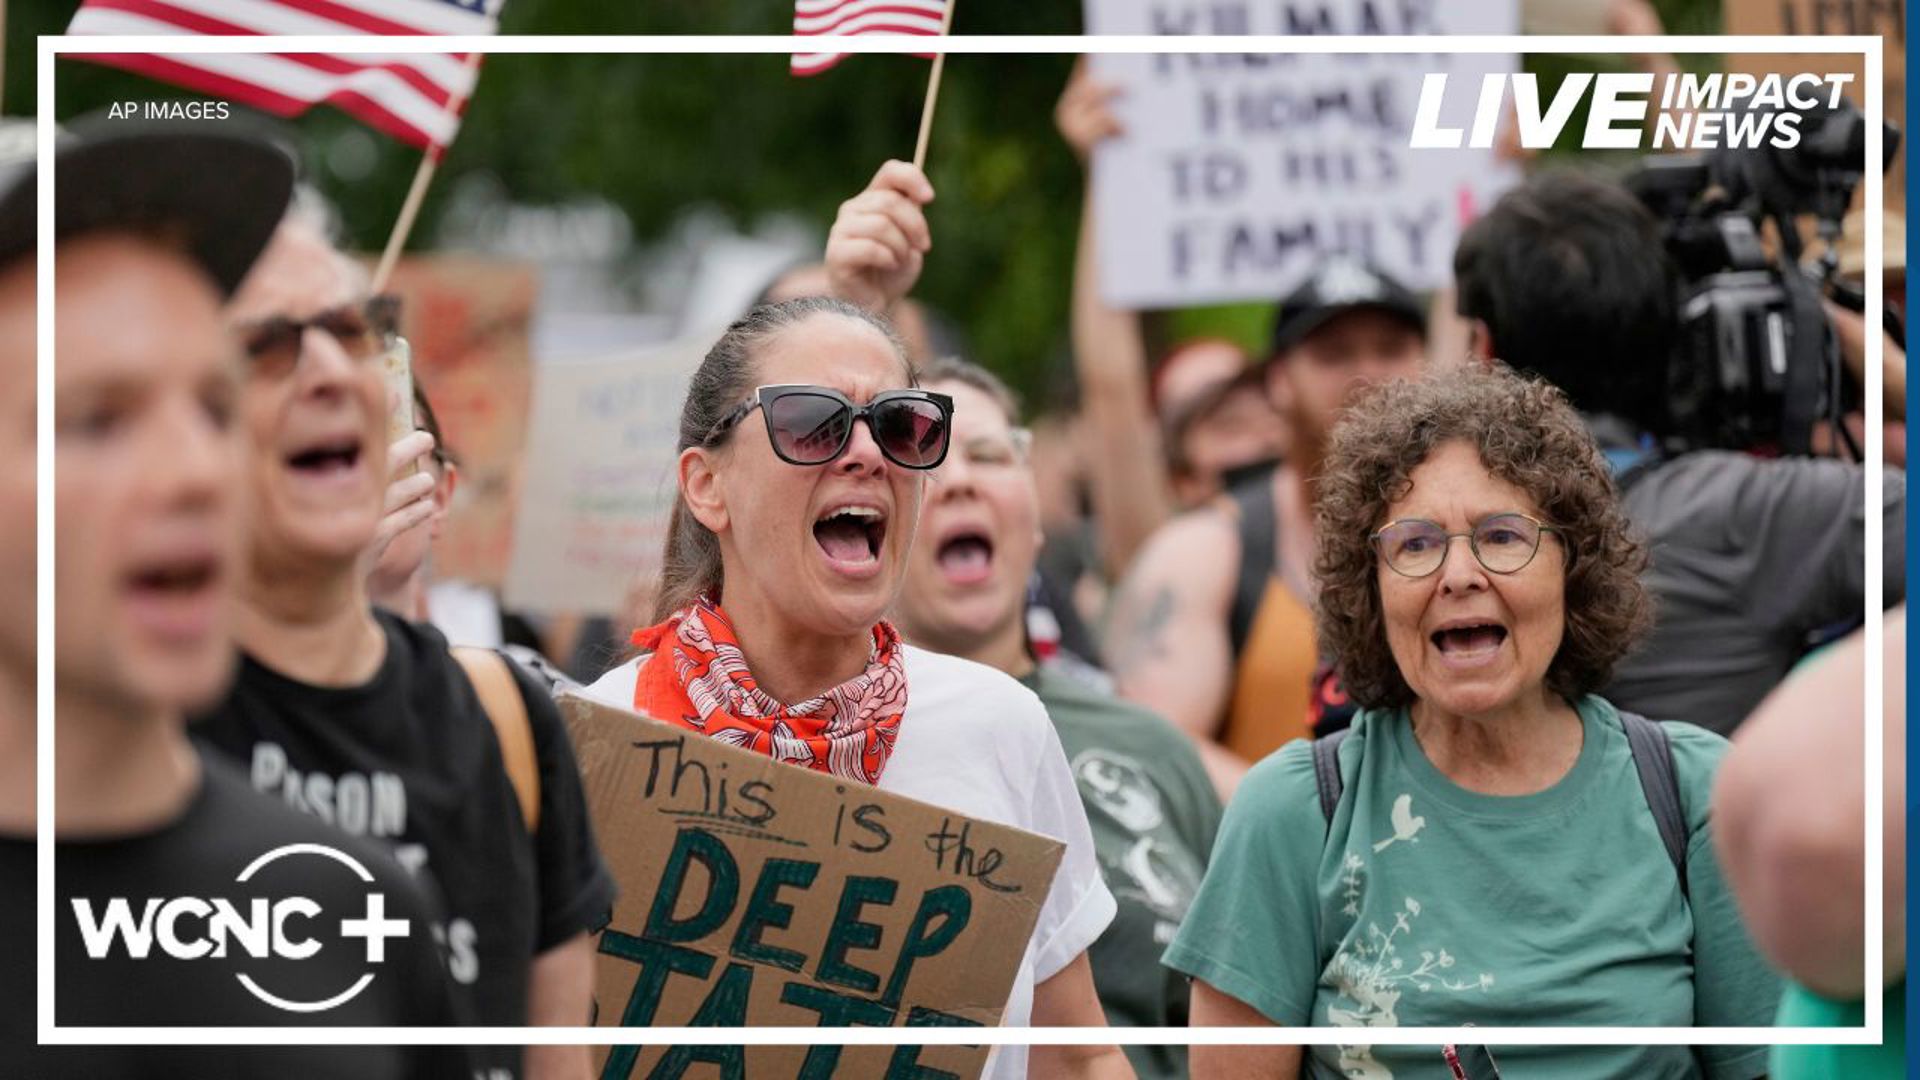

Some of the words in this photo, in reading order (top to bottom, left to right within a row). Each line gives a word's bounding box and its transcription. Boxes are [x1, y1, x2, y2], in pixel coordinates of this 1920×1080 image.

[1169, 153, 1248, 199] TO
[1170, 203, 1439, 278] FAMILY
[633, 735, 777, 828] This
[834, 785, 891, 853] is
[925, 817, 1022, 893] the
[641, 827, 972, 1009] DEEP
